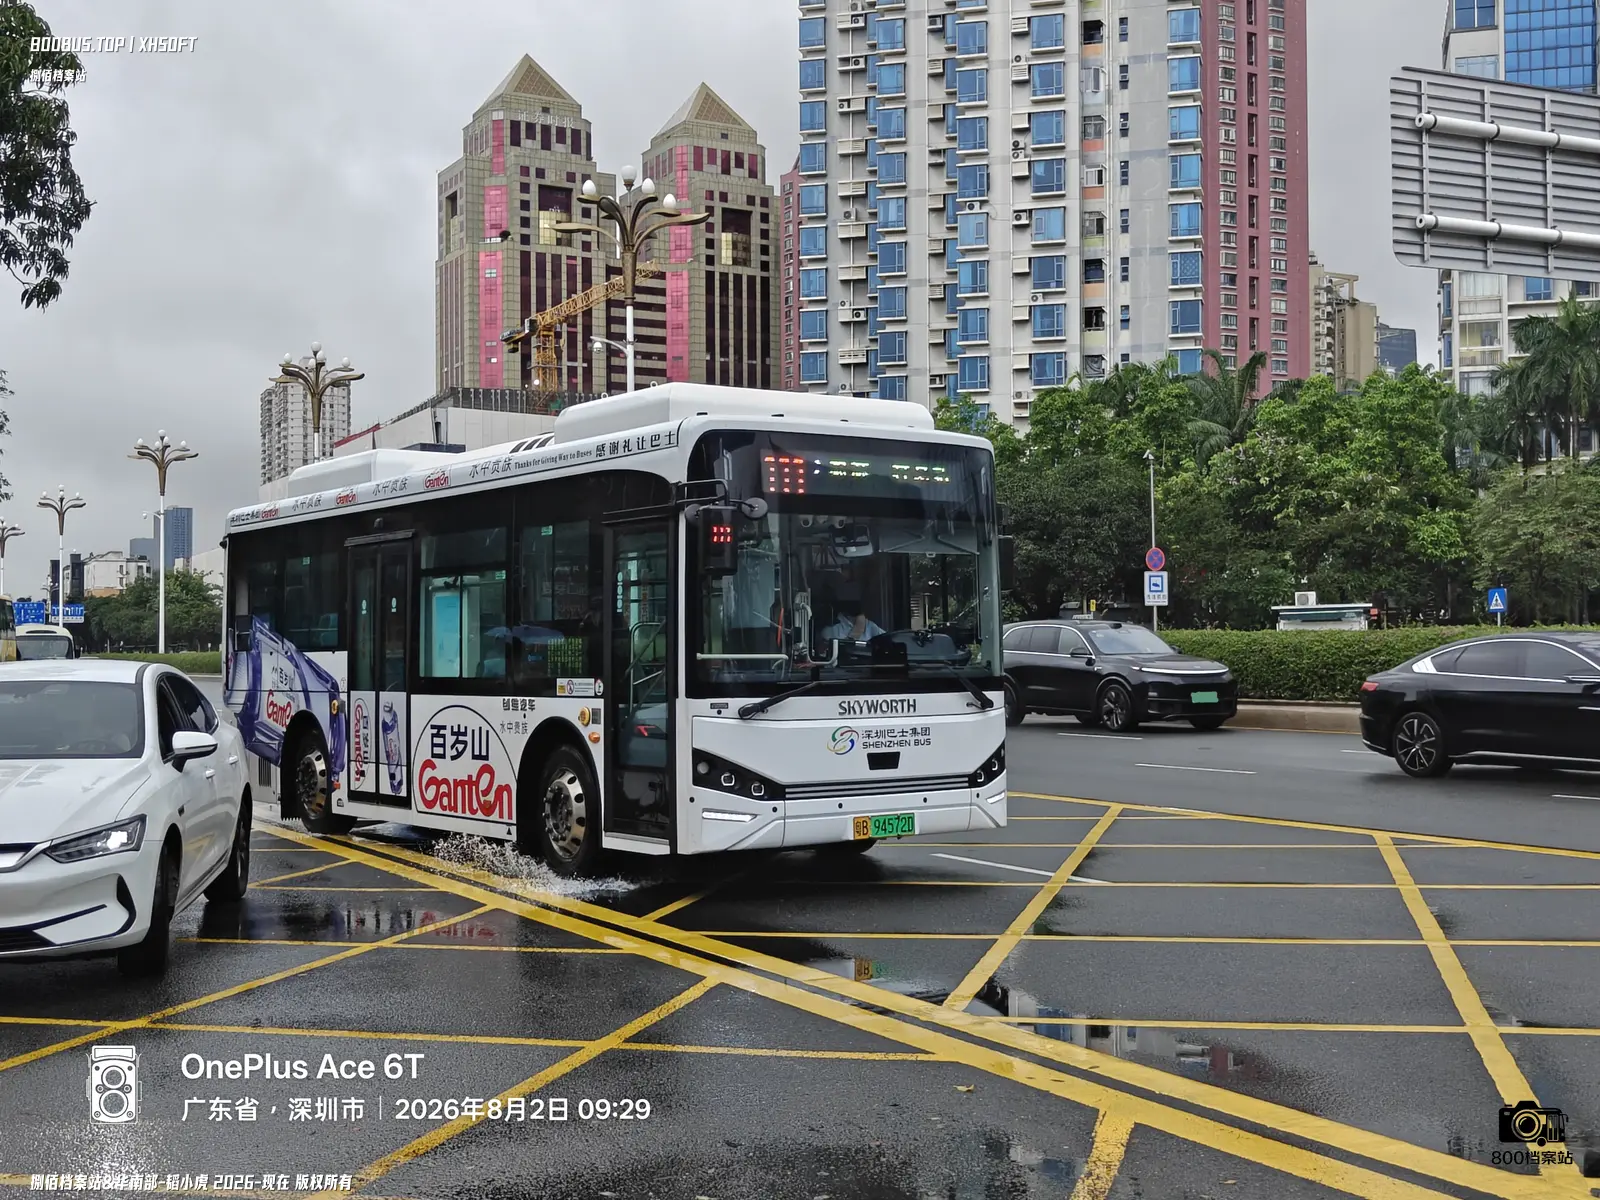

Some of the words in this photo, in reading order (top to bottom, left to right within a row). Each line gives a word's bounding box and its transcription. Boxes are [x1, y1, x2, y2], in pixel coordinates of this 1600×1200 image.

[595, 431, 675, 458] 感谢礼让巴士
[514, 461, 532, 470] Thanks
[532, 458, 541, 467] for
[541, 456, 558, 465] Giving
[558, 453, 569, 462] Way
[576, 450, 592, 459] Buses
[838, 699, 917, 716] SKYWORTH
[430, 724, 490, 761] 百岁山
[861, 727, 930, 740] 深圳巴士集团
[862, 739, 911, 749] SHENZHEN
[913, 738, 932, 746] BUS
[418, 759, 513, 820] Ganten
[873, 816, 914, 836] 94572D
